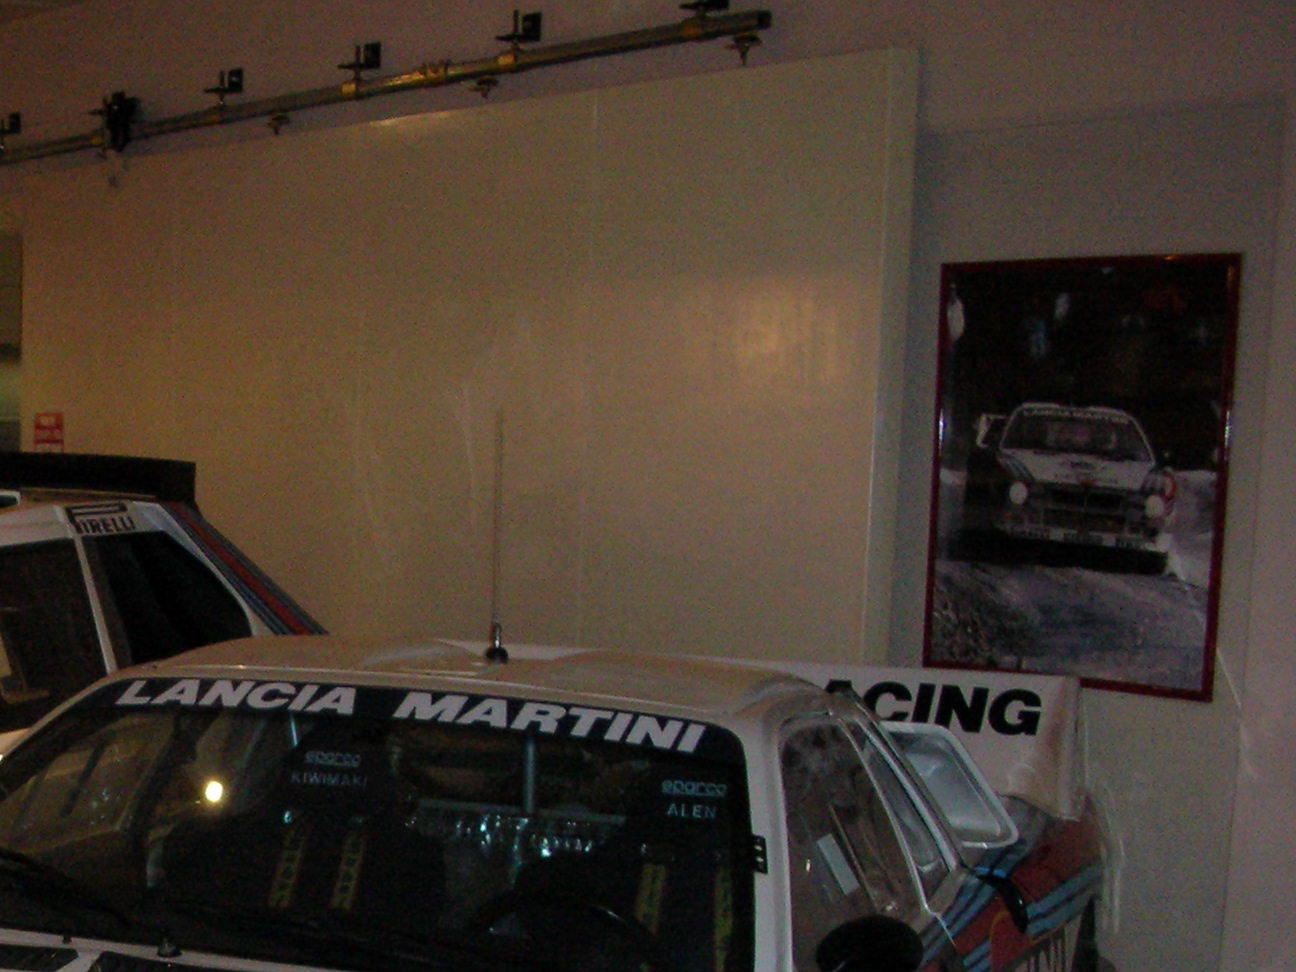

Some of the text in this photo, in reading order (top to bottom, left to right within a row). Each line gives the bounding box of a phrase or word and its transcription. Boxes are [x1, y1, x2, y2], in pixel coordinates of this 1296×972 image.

[66, 502, 135, 534] PIRELLI
[116, 678, 705, 754] LANCIA MARTINI
[667, 802, 717, 819] ALEN
